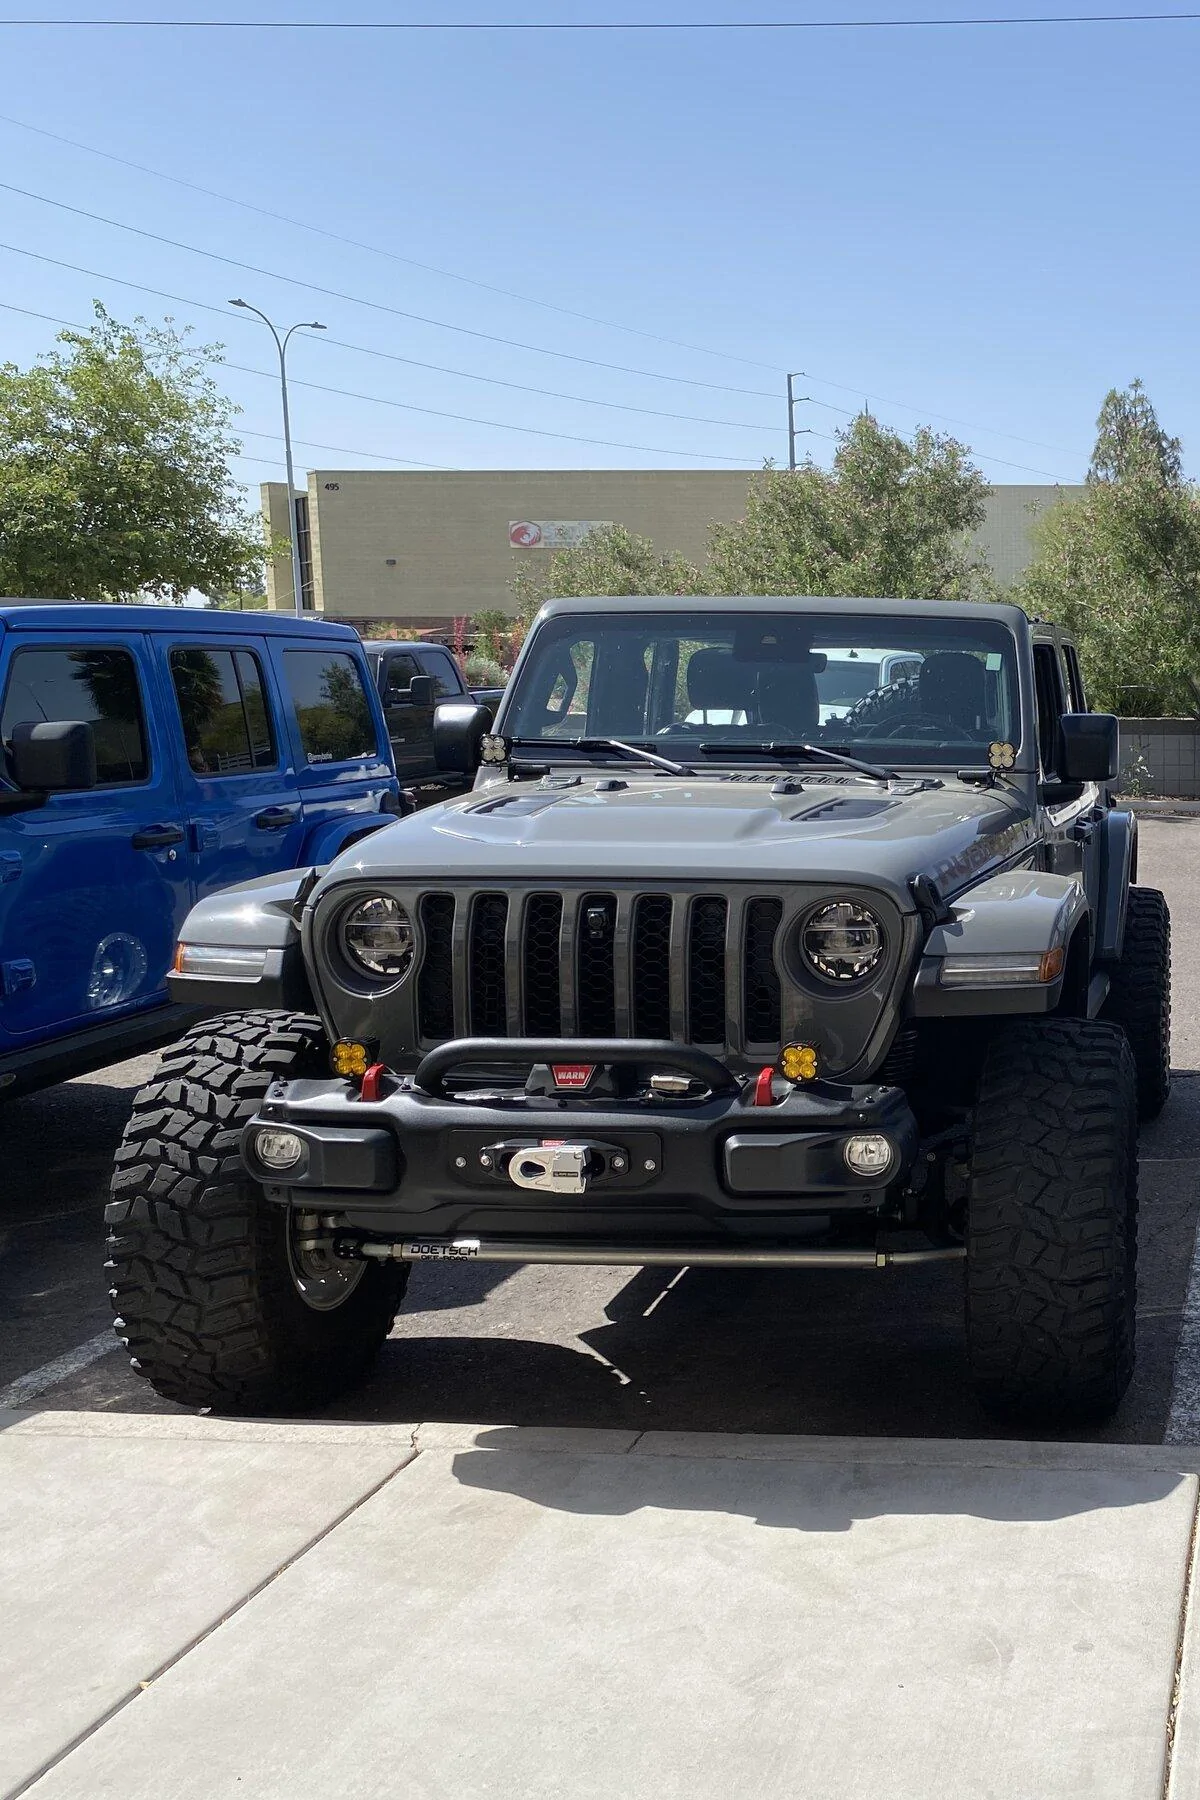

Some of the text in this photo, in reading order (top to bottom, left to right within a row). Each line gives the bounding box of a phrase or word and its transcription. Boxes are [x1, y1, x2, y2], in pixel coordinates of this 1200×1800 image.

[324, 483, 340, 491] 495
[557, 1071, 586, 1080] WARN
[410, 1244, 478, 1256] DOETSCH
